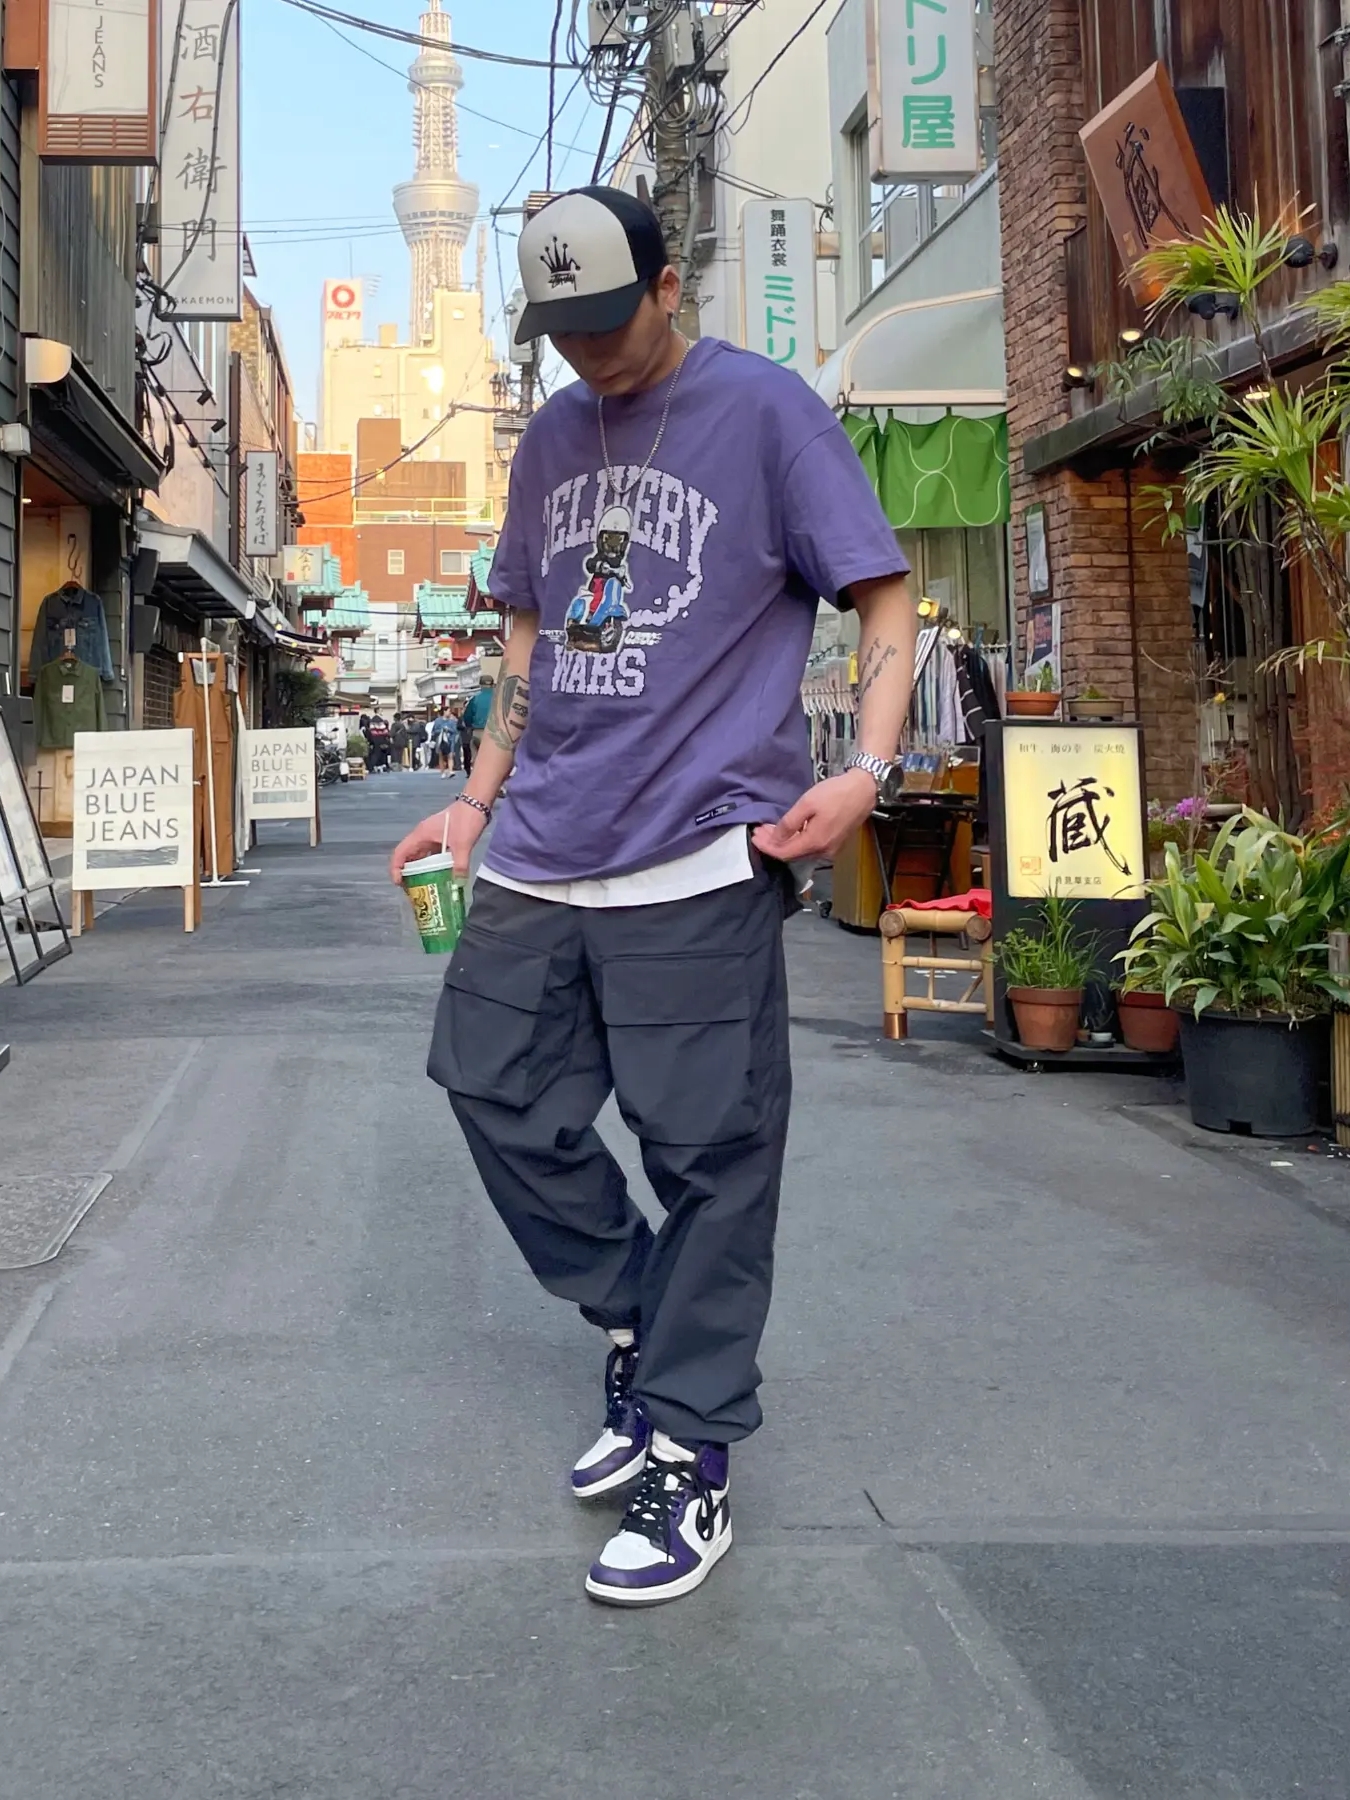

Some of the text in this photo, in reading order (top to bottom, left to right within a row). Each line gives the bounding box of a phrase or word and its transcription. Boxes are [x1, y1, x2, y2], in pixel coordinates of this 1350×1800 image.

[92, 15, 106, 88] JEANS
[176, 23, 227, 262] 酒右衛門
[769, 209, 788, 267] 舞踊衣裳
[764, 275, 798, 372] ミドリ
[253, 462, 269, 545] まぐろそば
[551, 644, 647, 697] WARS
[86, 764, 180, 789] JAPAN
[251, 743, 308, 757] JAPAN
[251, 758, 294, 772] BLUE
[86, 792, 156, 815] BLUE
[252, 773, 308, 789] JEANS
[86, 818, 180, 843] JEANS
[1045, 776, 1133, 877] 蔵
